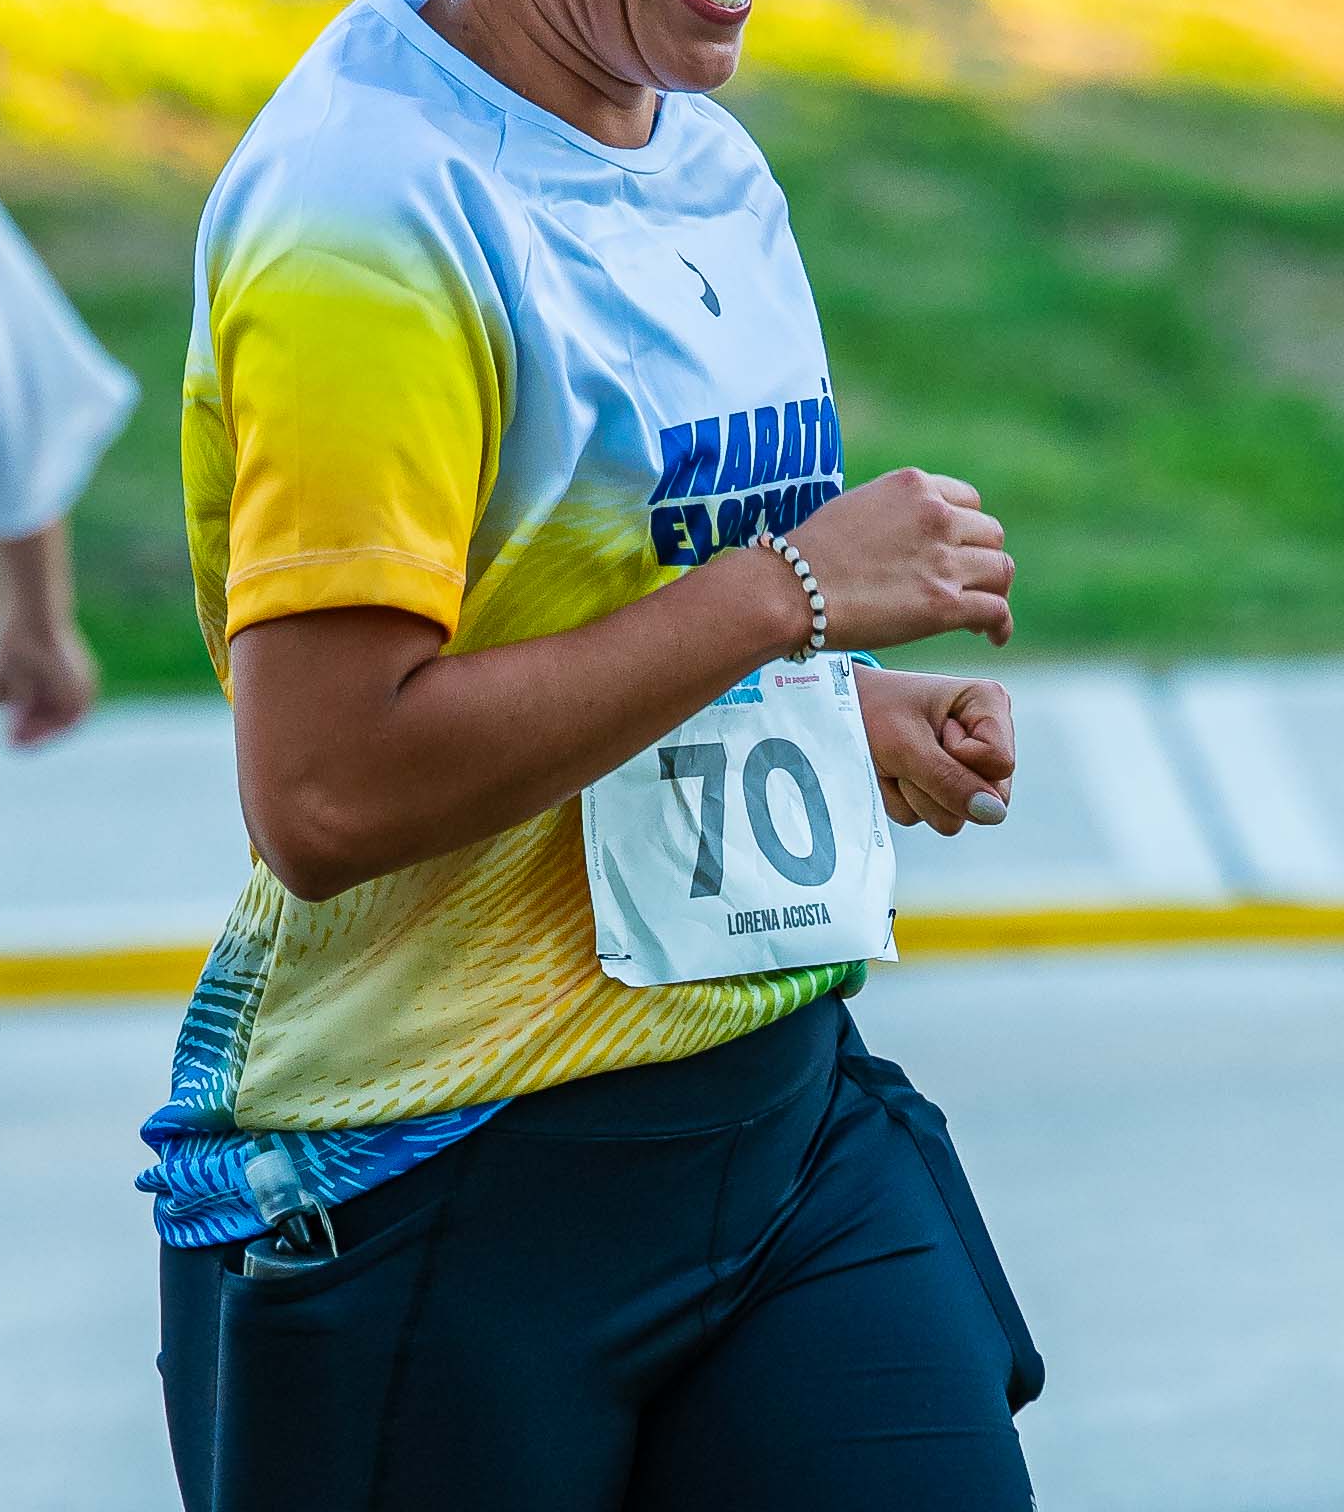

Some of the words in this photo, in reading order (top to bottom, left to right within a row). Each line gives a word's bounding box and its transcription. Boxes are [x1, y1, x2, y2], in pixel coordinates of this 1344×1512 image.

[648, 377, 843, 505] MARATÓ
[657, 738, 837, 898] 70
[727, 908, 780, 936] LORENA
[782, 902, 831, 929] ACOSTA
